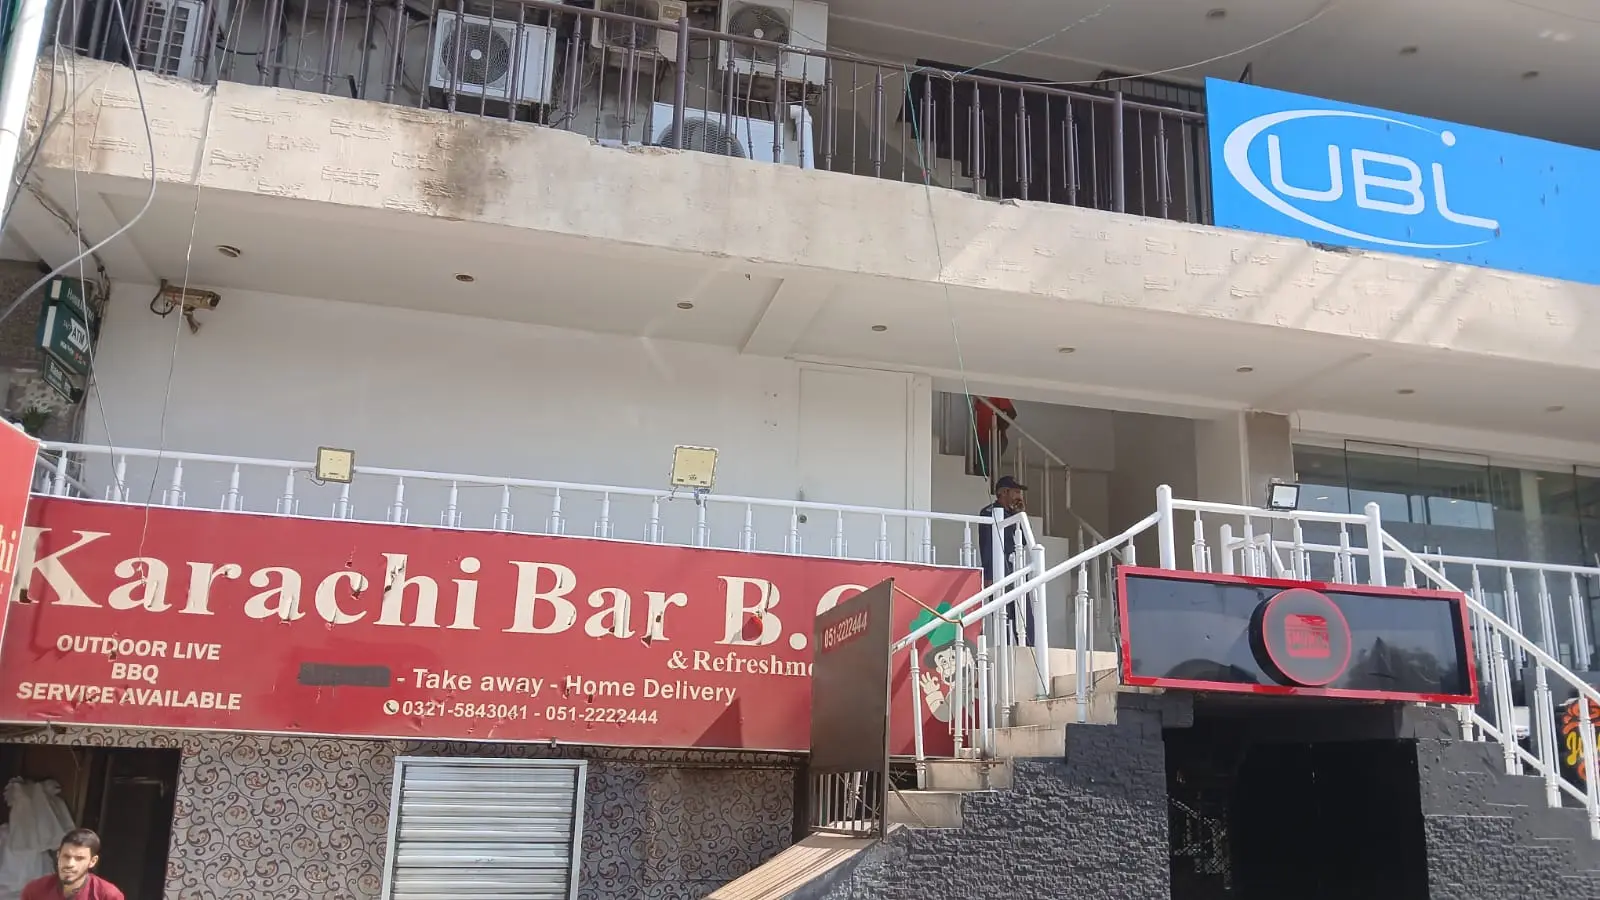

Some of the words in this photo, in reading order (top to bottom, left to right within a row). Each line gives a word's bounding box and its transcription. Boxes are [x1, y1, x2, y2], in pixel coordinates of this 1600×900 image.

[1267, 134, 1499, 229] UBL
[14, 526, 481, 629] Karachi
[502, 561, 687, 640] Bar
[57, 634, 168, 658] OUTDOOR
[173, 641, 222, 660] LIVE
[666, 650, 688, 671] &
[111, 662, 159, 684] BBQ
[16, 682, 115, 704] SERVICE
[119, 688, 242, 710] AVAILABLE
[412, 668, 472, 691] Take
[480, 675, 544, 697] away
[565, 674, 636, 698] Home
[643, 678, 737, 706] Delivery
[402, 699, 527, 721] 0321-5843041
[545, 705, 659, 725] 051-2222444
